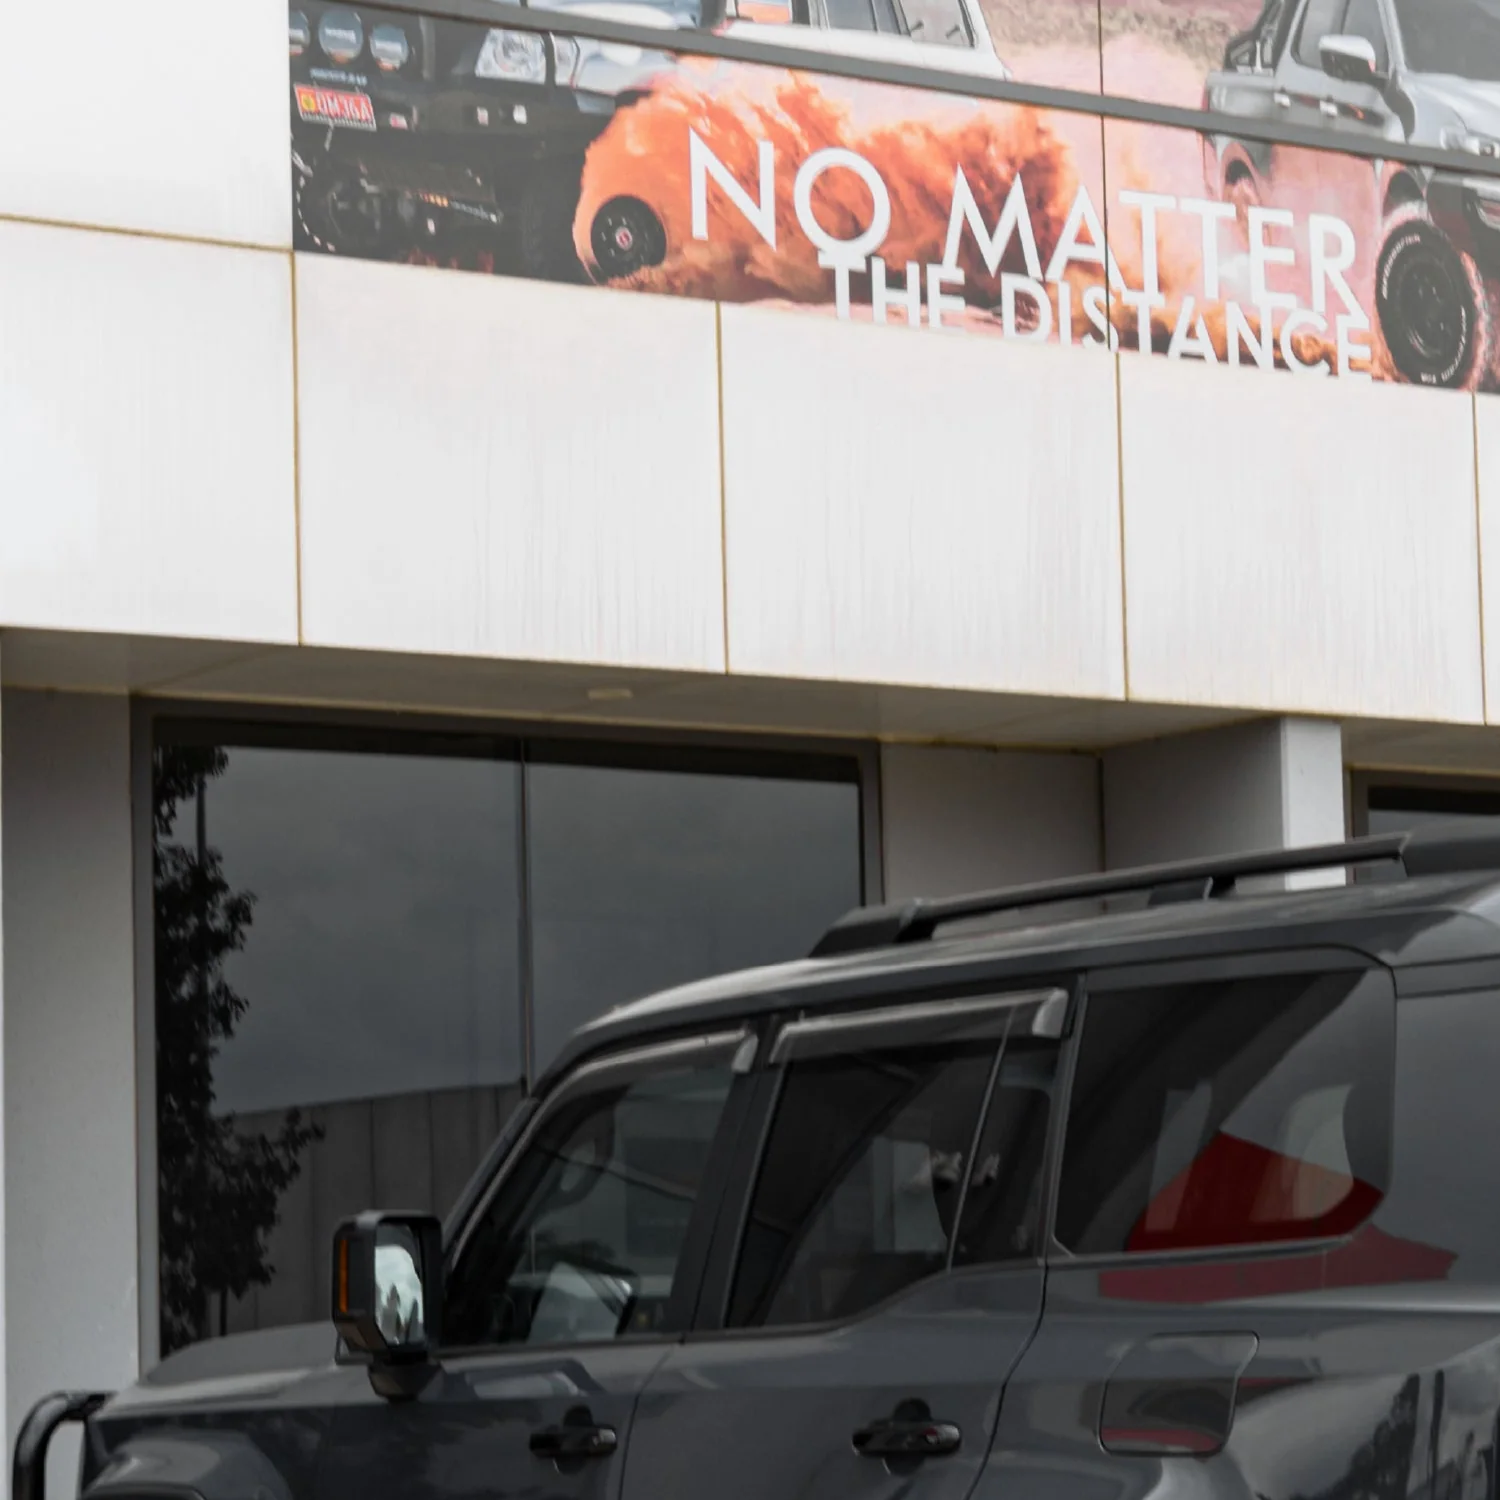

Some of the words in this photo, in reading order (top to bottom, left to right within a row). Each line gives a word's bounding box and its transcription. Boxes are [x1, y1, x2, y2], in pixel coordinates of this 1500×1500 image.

[688, 125, 892, 258] NO
[940, 161, 1370, 328] MATTER
[817, 248, 966, 332] THE
[1000, 271, 1373, 381] DISTANCE
